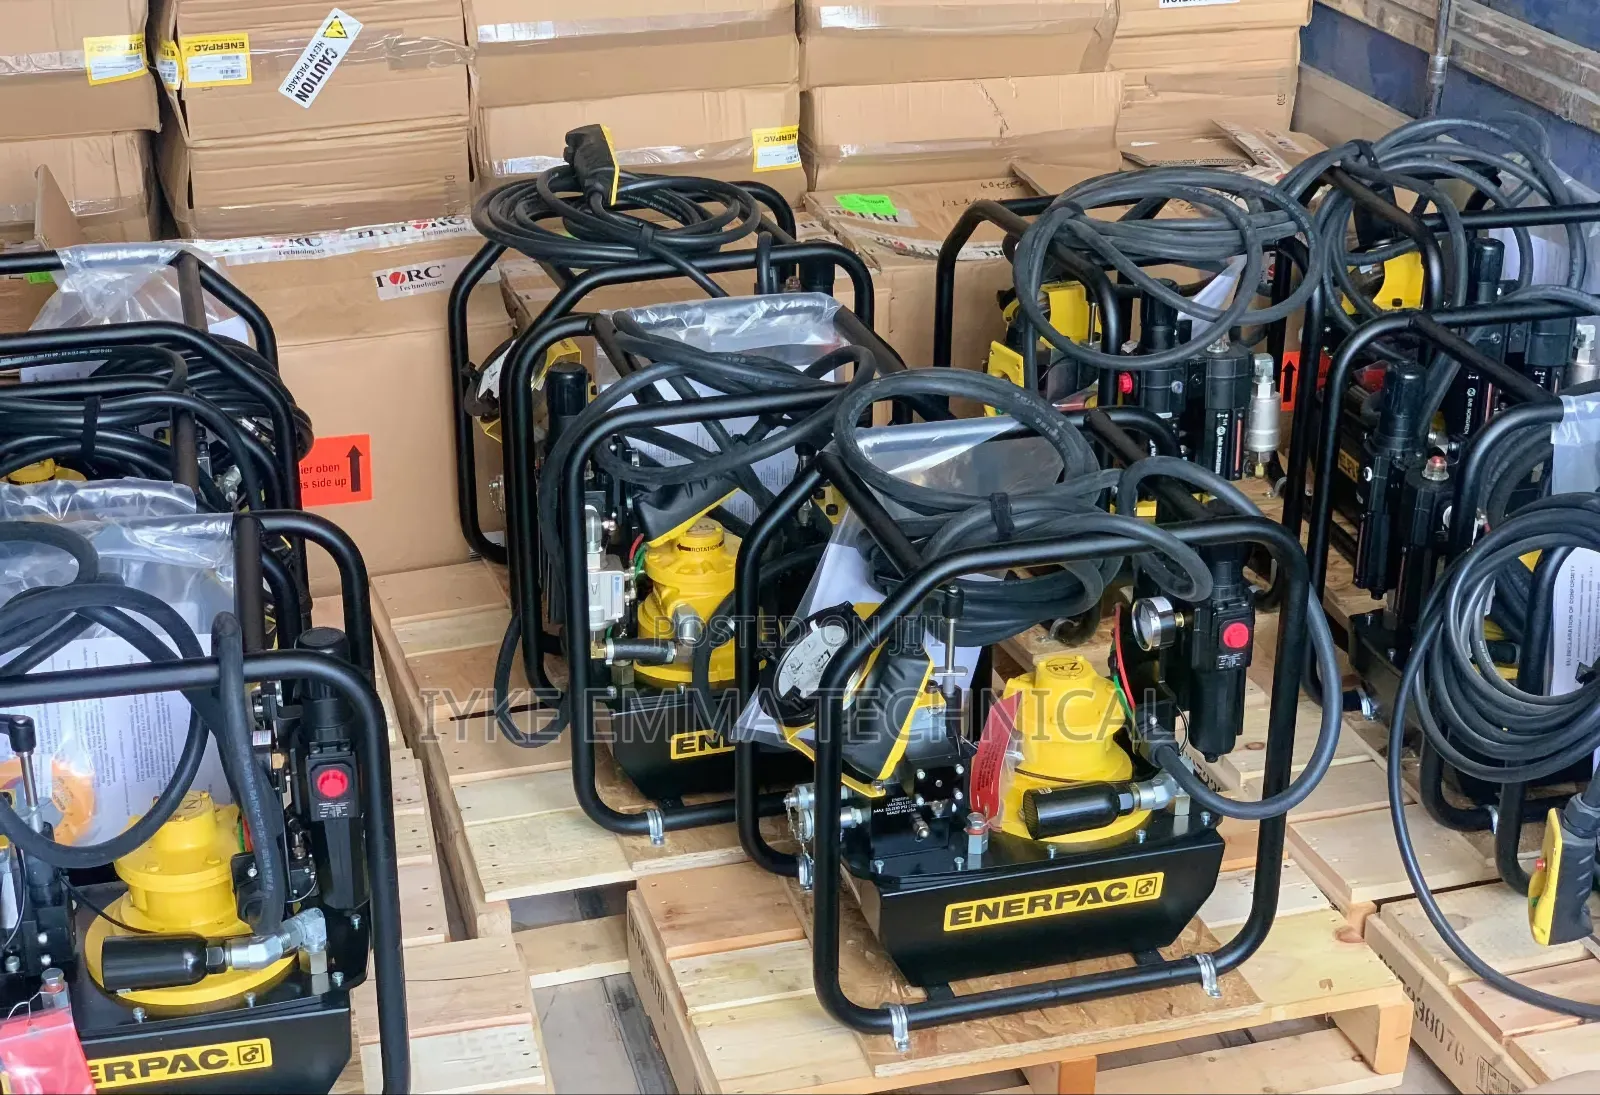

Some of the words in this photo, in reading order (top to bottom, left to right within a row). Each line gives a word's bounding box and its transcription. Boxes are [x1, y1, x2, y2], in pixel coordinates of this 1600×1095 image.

[194, 41, 245, 52] ENERPAC
[286, 62, 310, 94] PACKAGE
[294, 48, 338, 102] CAUTION
[764, 132, 797, 143] NERPAC
[300, 465, 312, 474] ier
[316, 463, 340, 473] oben
[312, 478, 332, 488] side
[335, 478, 347, 488] up
[690, 544, 719, 552] ROTATION
[950, 882, 1128, 926] ENERPAC
[89, 1048, 228, 1084] ERPAC
